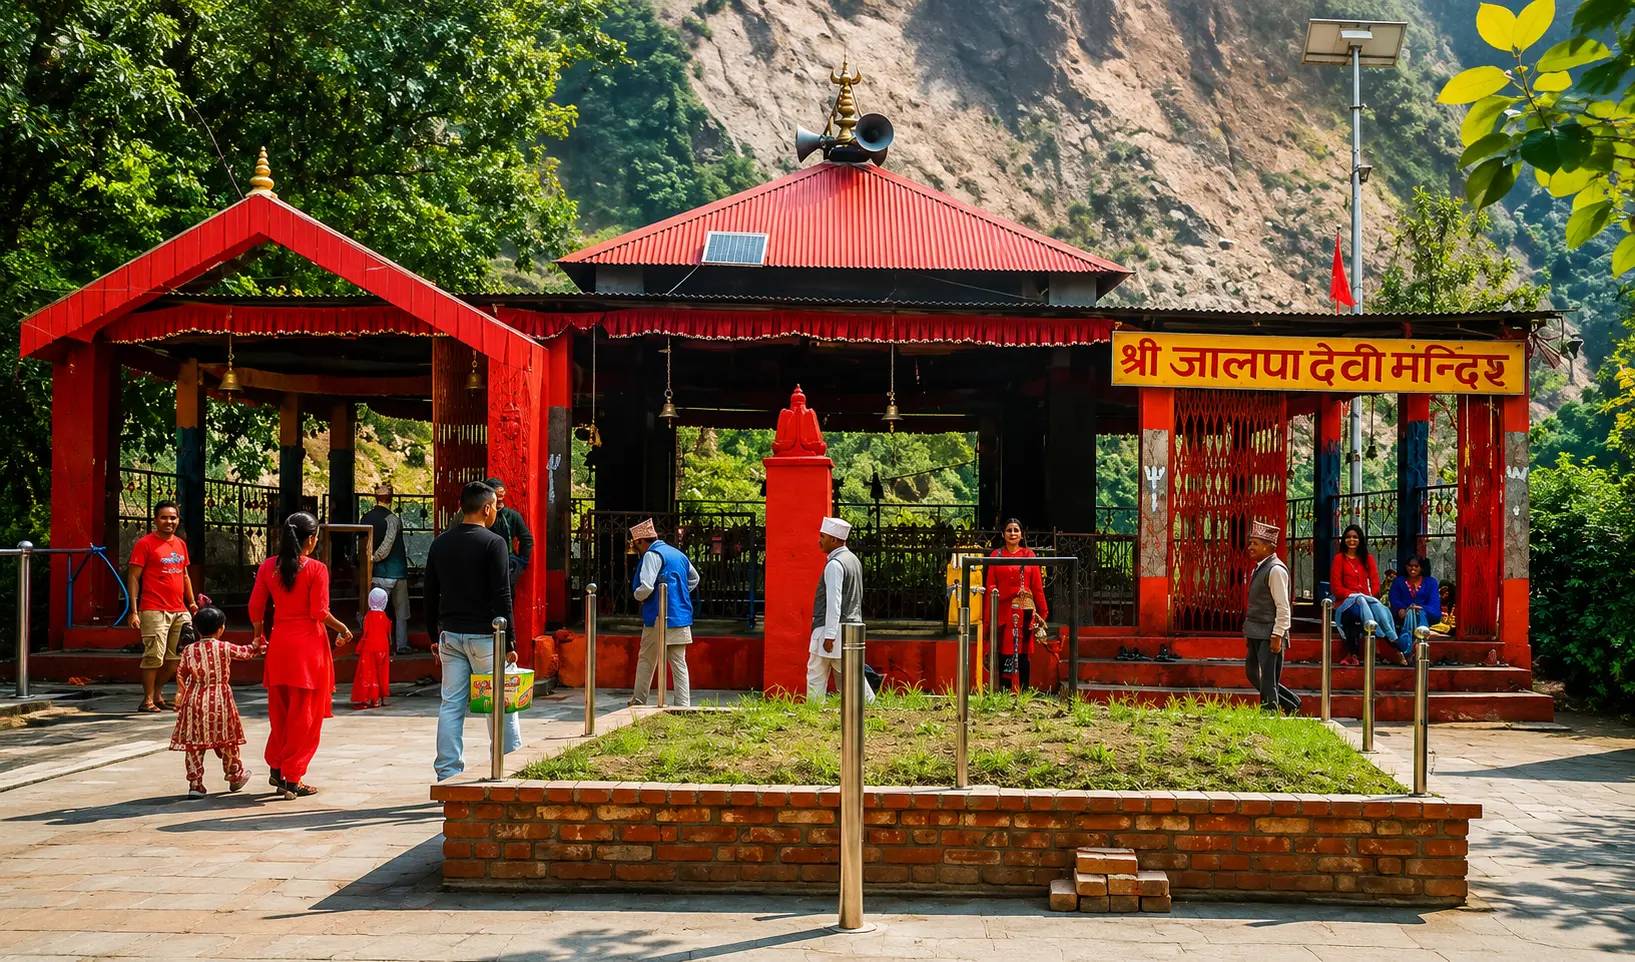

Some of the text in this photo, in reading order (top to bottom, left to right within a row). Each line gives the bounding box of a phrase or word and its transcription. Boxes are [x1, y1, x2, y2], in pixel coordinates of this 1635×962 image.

[1121, 338, 1162, 376] श्री
[1170, 347, 1304, 380] जालपा
[1309, 343, 1386, 386] देवी
